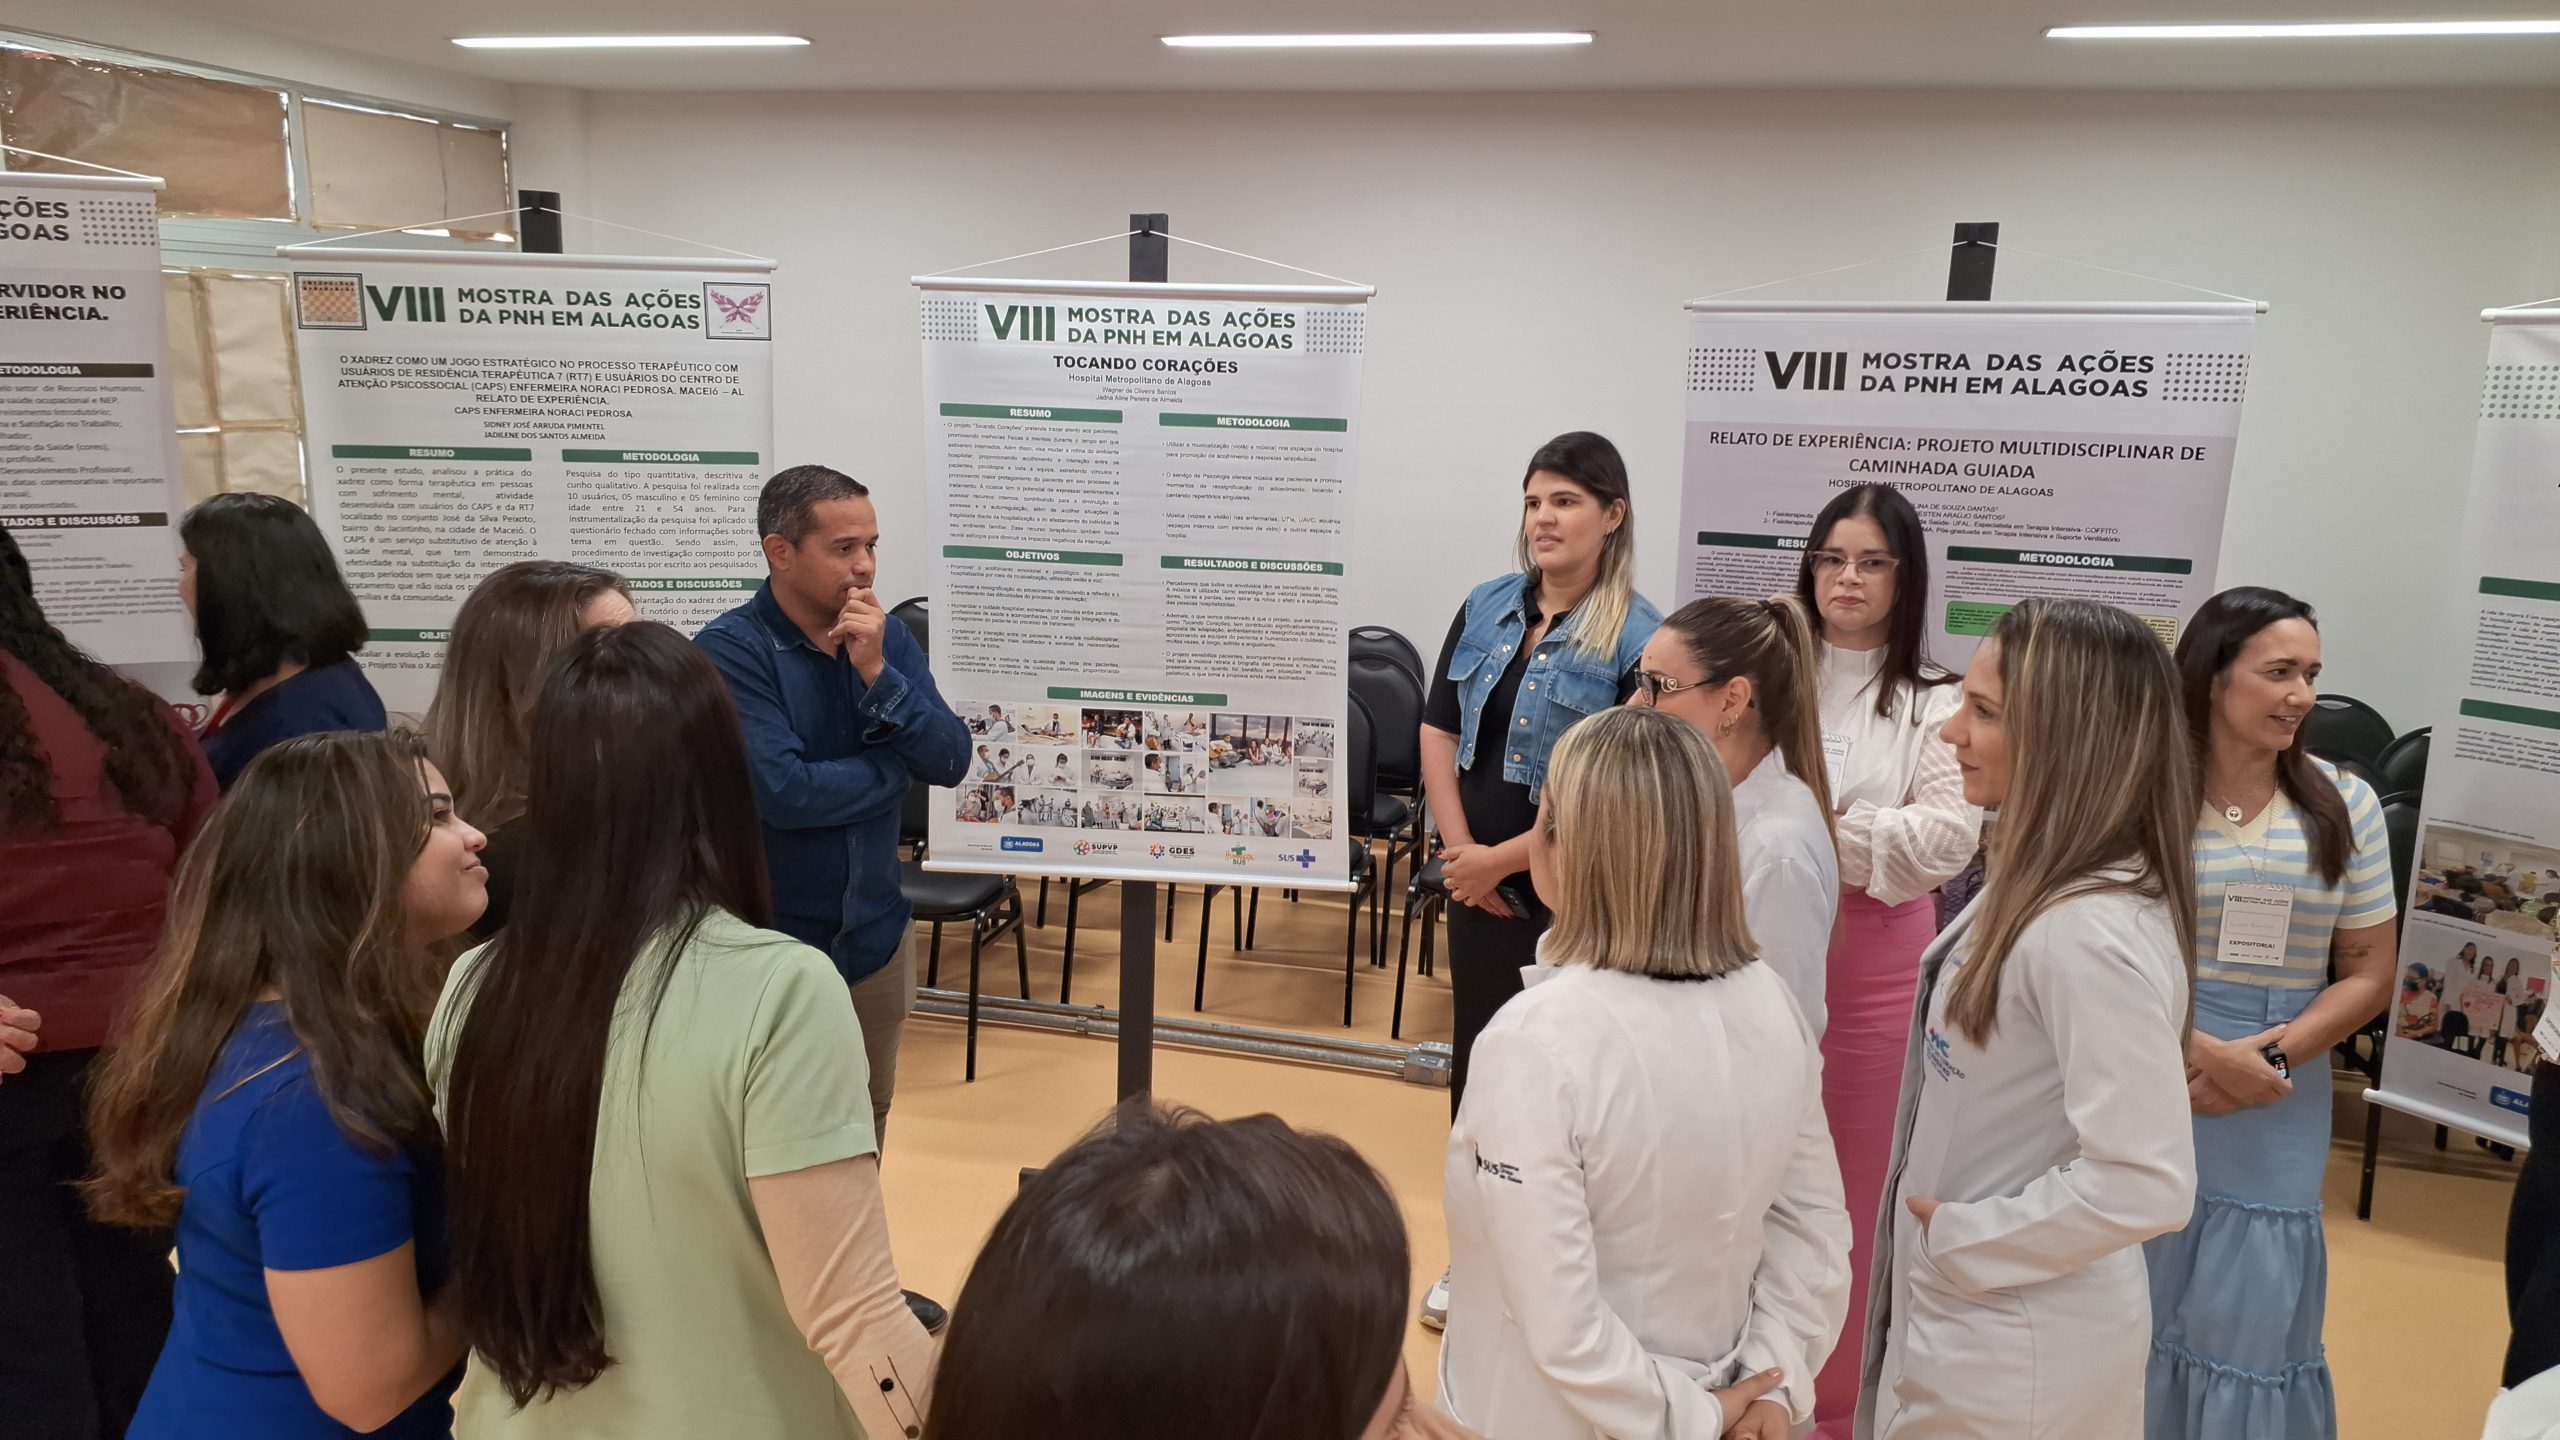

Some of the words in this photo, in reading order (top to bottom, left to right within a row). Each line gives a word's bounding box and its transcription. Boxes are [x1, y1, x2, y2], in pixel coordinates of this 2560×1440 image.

[366, 285, 446, 322] VIII
[458, 288, 554, 305] MOSTRA
[566, 291, 612, 307] DAS
[625, 289, 701, 311] AÇÕES
[459, 308, 492, 324] DA
[499, 309, 544, 325] PNH
[552, 311, 583, 326] EM
[590, 312, 700, 329] ALAGOAS
[984, 304, 1055, 341] VIII
[1068, 307, 1155, 324] MOSTRA
[1168, 310, 1210, 326] DAS
[1223, 308, 1296, 330] AÇÕES
[1068, 328, 1098, 343] DA
[1104, 329, 1146, 345] PNH
[1153, 330, 1182, 346] EM
[1188, 332, 1293, 349] ALAGOAS
[340, 355, 349, 364] O
[350, 356, 394, 364] XADREZ
[396, 356, 429, 365] COMO
[431, 357, 448, 365] UM
[450, 358, 480, 366] JOGO
[483, 357, 557, 368] ESTRATÉGICO
[578, 361, 636, 370] PROCESSO
[638, 361, 712, 372] TERAPÊUTICO
[715, 364, 738, 372] COM
[1053, 356, 1136, 370] TOCANDO
[1143, 358, 1238, 376] CORAÇÕES
[1862, 353, 1971, 370] MOSTRA
[1986, 354, 2042, 371] DAS
[2057, 350, 2154, 375] AÇÕES
[340, 367, 395, 377] USUÁRIOS
[397, 368, 413, 377] DE
[415, 368, 480, 378] RESIDÊNCIA
[481, 370, 555, 380] TERAPÊUTICA
[566, 372, 592, 382] (RT7)
[595, 373, 602, 381] E
[605, 372, 658, 382] USUÁRIOS
[680, 375, 722, 383] CENTRO
[1764, 351, 1848, 391] VIII
[337, 379, 388, 390] ATENÇÃO
[390, 380, 469, 390] PSICOSSOCIAL
[471, 382, 507, 392] (CAPS)
[510, 383, 578, 392] ENFERMEIRA
[580, 385, 620, 393] NORACI
[624, 386, 676, 394] PEDROSA.
[1069, 374, 1103, 383] Hospital
[1106, 375, 1162, 385] Metropolitano
[1177, 377, 1211, 387] Alagoas
[1860, 375, 1896, 392] DA
[1904, 376, 1958, 393] PNH
[1966, 377, 2003, 394] EM
[2010, 378, 2148, 397] ALAGOAS
[476, 394, 518, 402] RELATO
[537, 395, 610, 404] EXPERIÊNCIA.
[483, 407, 546, 416] ENFERMEIRA
[1010, 408, 1052, 418] RESUMO
[1217, 417, 1290, 428] METODOLOGIA
[409, 449, 455, 457] RESUMO
[1710, 432, 1768, 445] RELATO
[1773, 434, 1794, 446] DE
[1799, 434, 1911, 450] EXPERIÊNCIA:
[1917, 438, 1994, 453] PROJETO
[2000, 441, 2174, 460] MULTIDISCIPLINAR
[2180, 447, 2206, 461] DE
[623, 453, 700, 461] METODOLOGIA
[566, 470, 602, 479] Pesquisa
[624, 471, 641, 479] tipo
[647, 471, 698, 480] quantitativa,
[1849, 459, 1958, 476] CAMINHADA
[1964, 463, 2035, 479] GUIADA
[595, 482, 641, 490] qualitativo.
[652, 483, 688, 491] pesquisa
[1980, 486, 1995, 494] DE
[1998, 486, 2054, 497] ALAGOAS
[47, 517, 57, 525] E
[59, 514, 140, 525] DISCUSSÕES
[1006, 550, 1060, 560] OBJETIVOS
[2019, 553, 2114, 567] METODOLOGIA
[1184, 558, 1248, 569] RESULTADOS
[1260, 561, 1323, 572] DISCUSSÕES
[676, 579, 742, 588] DISCUSSÕES
[1080, 690, 1124, 700] IMAGENS
[1135, 692, 1194, 702] EVIDÊNCIAS
[1169, 847, 1195, 856] GDES
